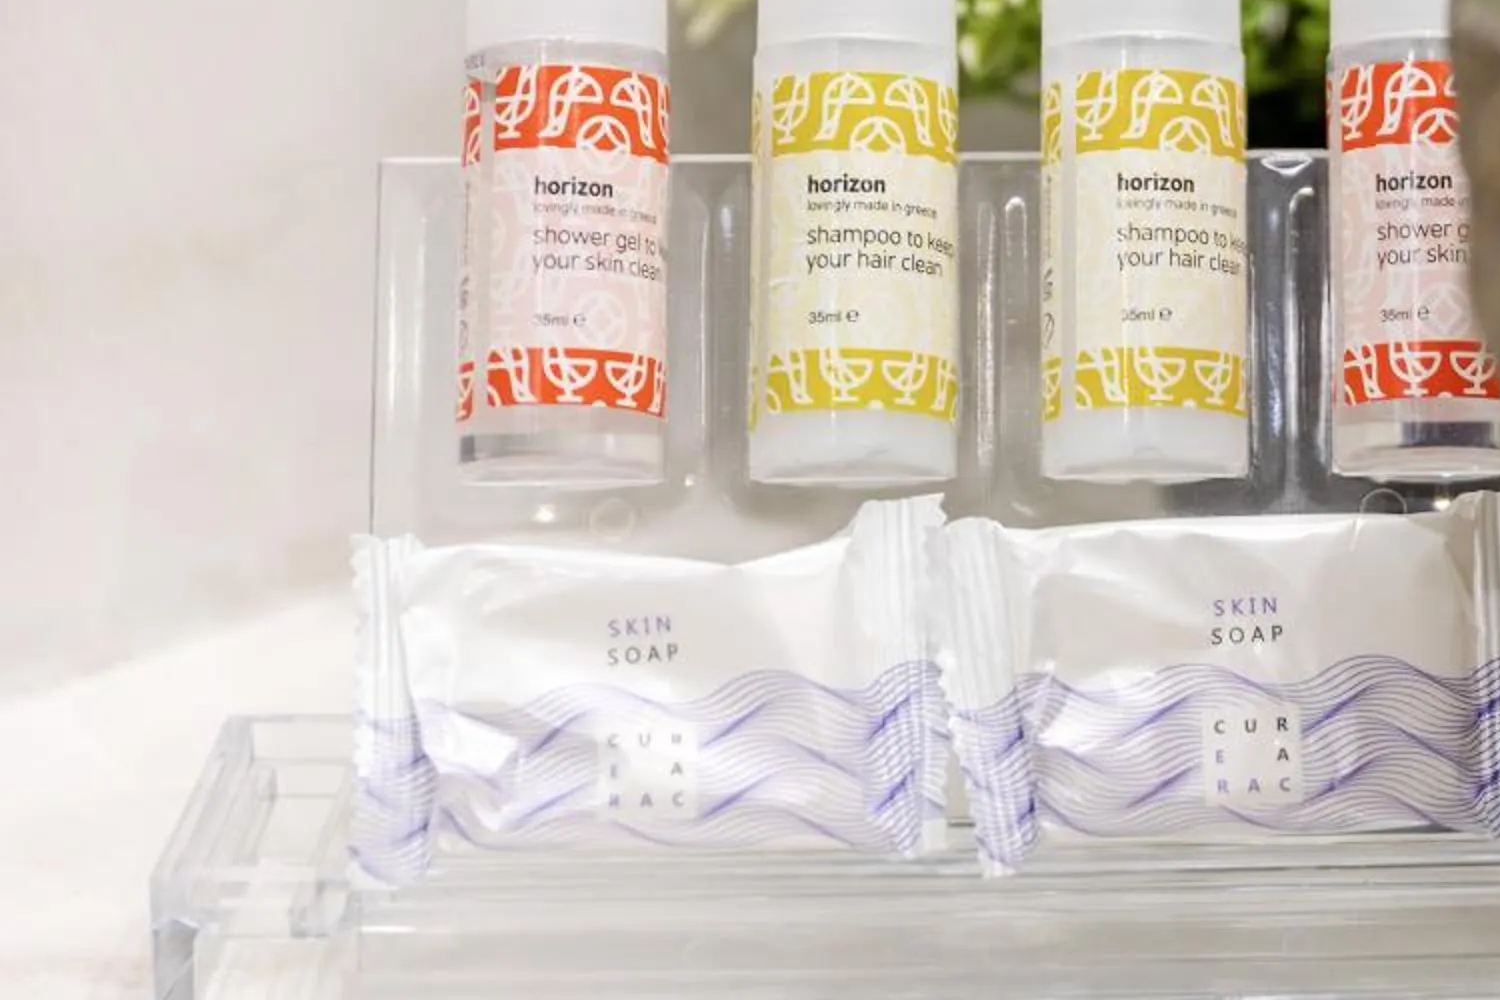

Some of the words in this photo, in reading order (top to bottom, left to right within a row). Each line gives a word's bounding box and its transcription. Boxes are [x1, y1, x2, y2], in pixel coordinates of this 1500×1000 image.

[534, 175, 614, 198] horizon
[807, 173, 886, 195] horizon
[1117, 172, 1196, 194] horizon
[1375, 170, 1453, 193] horizon
[854, 200, 888, 212] made
[891, 201, 902, 212] in
[1421, 197, 1456, 208] made
[533, 225, 610, 247] shower
[615, 232, 641, 254] gel
[807, 225, 902, 247] shampoo
[907, 231, 923, 249] to
[1117, 222, 1209, 246] shampoo
[1214, 231, 1228, 249] to
[1377, 221, 1452, 241] shower
[532, 253, 580, 276] your
[585, 252, 624, 274] skin
[806, 252, 852, 274] your
[857, 249, 896, 270] hair
[901, 253, 943, 277] clean
[1117, 251, 1164, 272] your
[1169, 248, 1206, 269] hair
[1427, 244, 1468, 265] skin
[808, 310, 842, 325] 35ml
[1213, 596, 1278, 617] SKIN
[606, 616, 672, 638] SKIN
[1210, 624, 1283, 646] SOAP
[606, 643, 680, 667] SOAP
